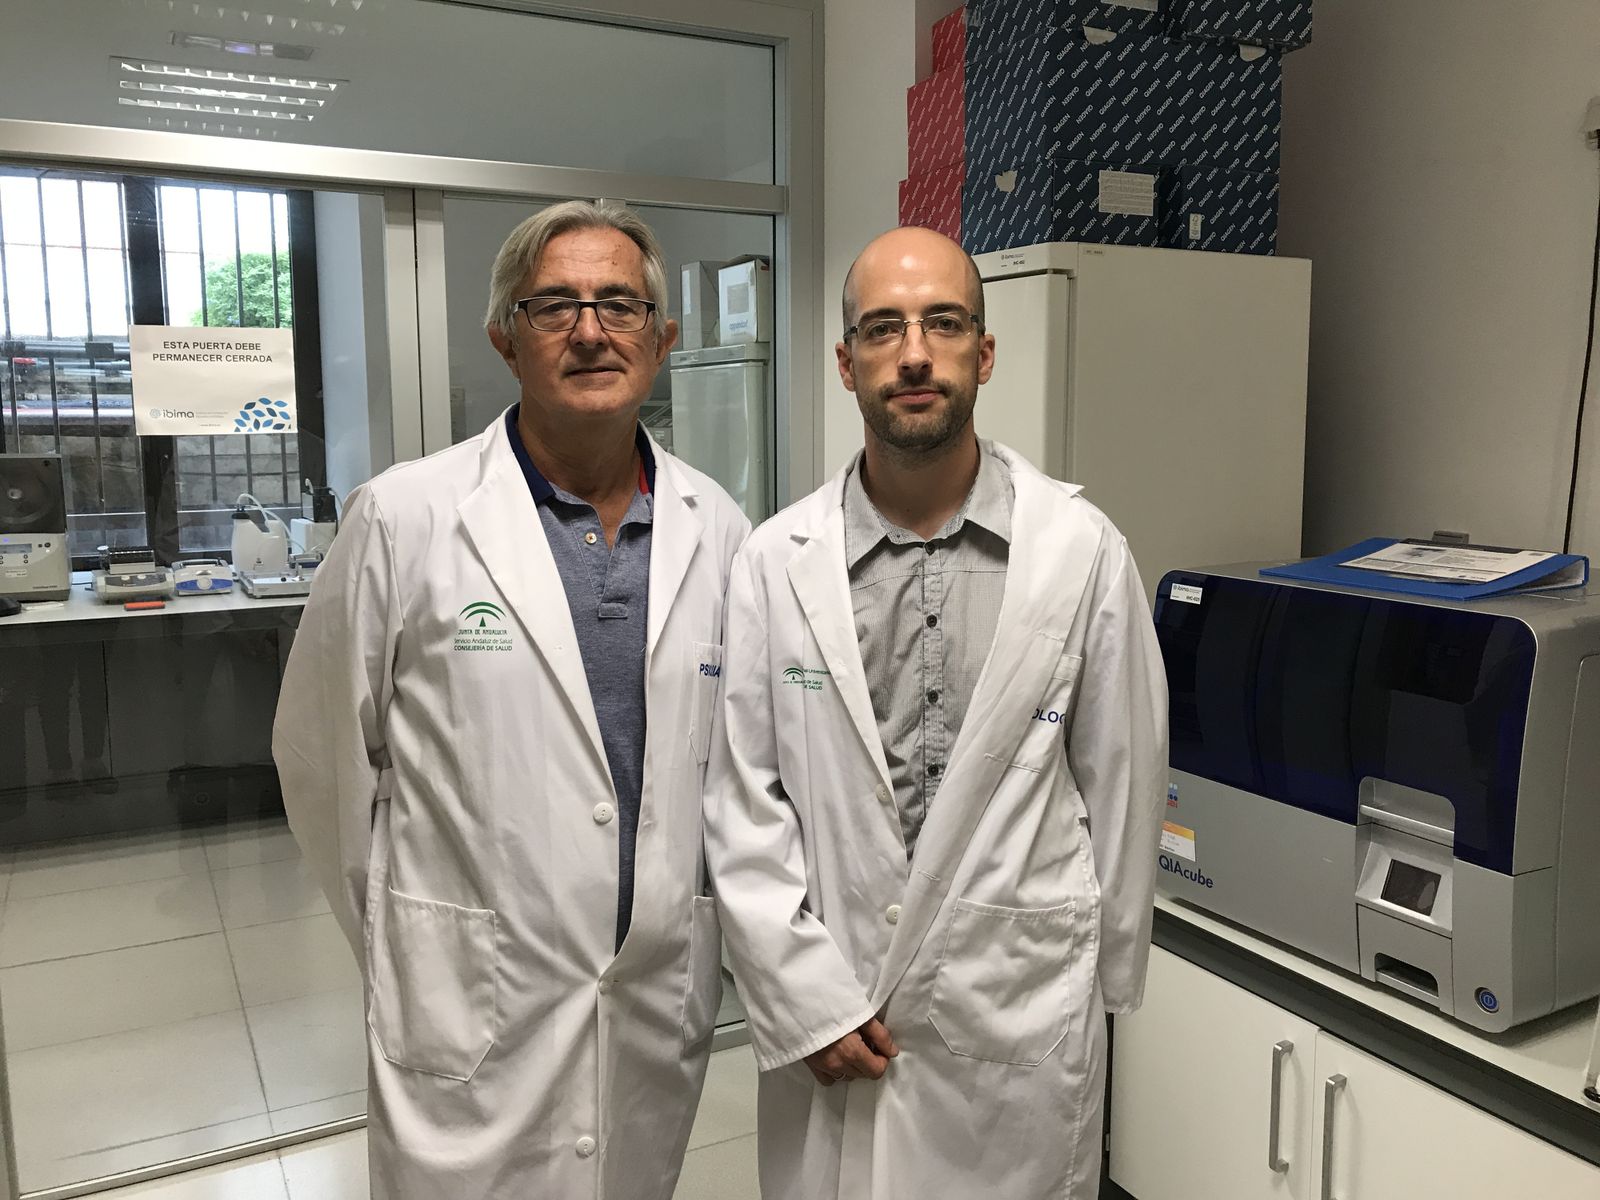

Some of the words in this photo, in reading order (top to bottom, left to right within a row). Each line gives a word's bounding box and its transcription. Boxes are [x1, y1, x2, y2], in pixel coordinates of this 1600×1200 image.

[1214, 10, 1230, 30] QIAGEN
[1234, 2, 1250, 21] QIAGEN
[1268, 11, 1283, 30] QIAGEN
[1288, 3, 1302, 22] QIAGEN
[1246, 20, 1262, 39] QIAGEN
[1057, 40, 1074, 60] QIAGEN
[1117, 42, 1134, 61] QIAGEN
[1175, 44, 1192, 62] QIAGEN
[1071, 59, 1088, 78] QIAGEN
[1094, 51, 1111, 70] QIAGEN
[1131, 60, 1148, 79] QIAGEN
[1152, 52, 1169, 71] QIAGEN
[1208, 54, 1223, 72] QIAGEN
[1259, 56, 1273, 74] QIAGEN
[1047, 68, 1065, 88] QIAGEN
[1108, 69, 1125, 88] QIAGEN
[1166, 70, 1182, 89] QIAGEN
[1187, 62, 1203, 80] QIAGEN
[1240, 64, 1254, 82] QIAGEN
[1086, 77, 1102, 96] QIAGEN
[1144, 78, 1160, 97] QIAGEN
[1199, 80, 1215, 98] QIAGEN
[1220, 72, 1234, 90] QIAGEN
[1251, 81, 1265, 100] QIAGEN
[1062, 86, 1079, 106] QIAGEN
[1099, 96, 1116, 115] QIAGEN
[1121, 87, 1138, 106] QIAGEN
[1157, 96, 1173, 115] QIAGEN
[1178, 88, 1194, 107] QIAGEN
[1231, 90, 1246, 108] QIAGEN
[1076, 104, 1093, 124] QIAGEN
[1134, 105, 1151, 124] QIAGEN
[1190, 106, 1206, 124] QIAGEN
[1211, 97, 1226, 116] QIAGEN
[1242, 107, 1257, 125] QIAGEN
[1262, 99, 1276, 117] QIAGEN
[1053, 113, 1070, 133] QIAGEN
[1090, 122, 1106, 142] QIAGEN
[1112, 114, 1129, 133] QIAGEN
[1147, 123, 1163, 142] QIAGEN
[1169, 114, 1185, 133] QIAGEN
[1222, 115, 1238, 134] QIAGEN
[1067, 131, 1084, 151] QIAGEN
[1125, 132, 1142, 150] QIAGEN
[1181, 132, 1197, 150] QIAGEN
[1202, 124, 1217, 142] QIAGEN
[1234, 132, 1249, 151] QIAGEN
[1254, 124, 1268, 142] QIAGEN
[1045, 141, 1061, 159] QIAGEN
[1102, 140, 1119, 160] QIAGEN
[1159, 141, 1176, 160] QIAGEN
[1213, 141, 1228, 160] QIAGEN
[1245, 150, 1260, 168] QIAGEN
[1264, 142, 1278, 160] QIAGEN
[1076, 173, 1092, 192] QIAGEN
[1187, 172, 1202, 190] QIAGEN
[1218, 181, 1232, 199] QIAGEN
[1237, 174, 1251, 191] QIAGEN
[1053, 181, 1071, 201] QIAGEN
[1199, 189, 1213, 207] QIAGEN
[1248, 190, 1262, 208] QIAGEN
[1266, 182, 1280, 200] QIAGEN
[1068, 200, 1084, 218] QIAGEN
[1178, 197, 1193, 216] QIAGEN
[1210, 206, 1224, 224] QIAGEN
[1229, 198, 1243, 216] QIAGEN
[1240, 216, 1254, 233] QIAGEN
[1258, 208, 1272, 225] QIAGEN
[1080, 217, 1097, 236] QIAGEN
[1134, 217, 1150, 236] QIAGEN
[1221, 223, 1235, 241] QIAGEN
[1250, 232, 1264, 250] QIAGEN
[163, 341, 190, 350] ESTA
[193, 342, 232, 350] PUERTA
[235, 342, 261, 350] DEBE
[152, 354, 223, 362] PERMANECER
[226, 354, 272, 363] CERRADA
[163, 409, 194, 418] ibima
[1159, 854, 1214, 888] QIAcube
